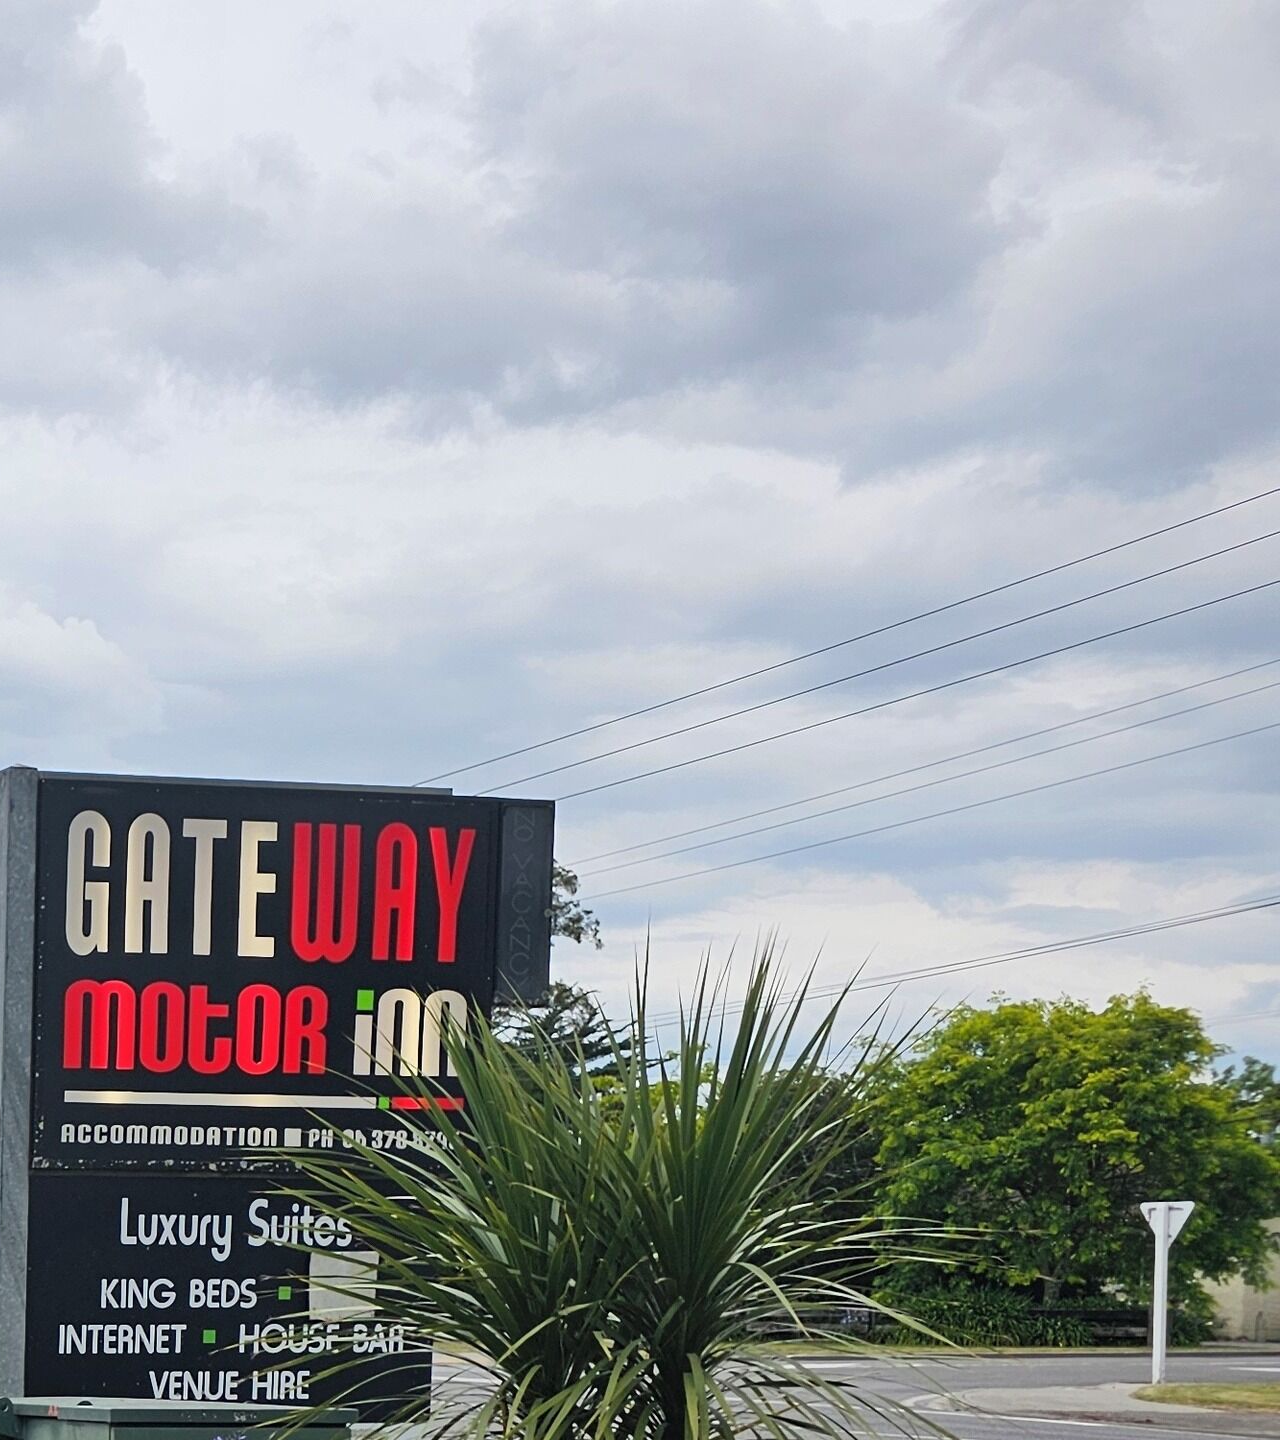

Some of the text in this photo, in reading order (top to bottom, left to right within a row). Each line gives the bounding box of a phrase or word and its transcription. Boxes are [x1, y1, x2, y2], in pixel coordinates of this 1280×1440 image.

[65, 810, 476, 964] GATEWAY
[61, 1123, 278, 1147] ACCOMMODATION
[308, 1129, 334, 1148] PH
[371, 1130, 408, 1149] 378
[120, 1197, 353, 1262] Luxury Suites
[100, 1278, 258, 1309] KING BEDS
[58, 1323, 405, 1355] INTERNET HOUSE BAR
[149, 1370, 311, 1400] VENUE HIRE
